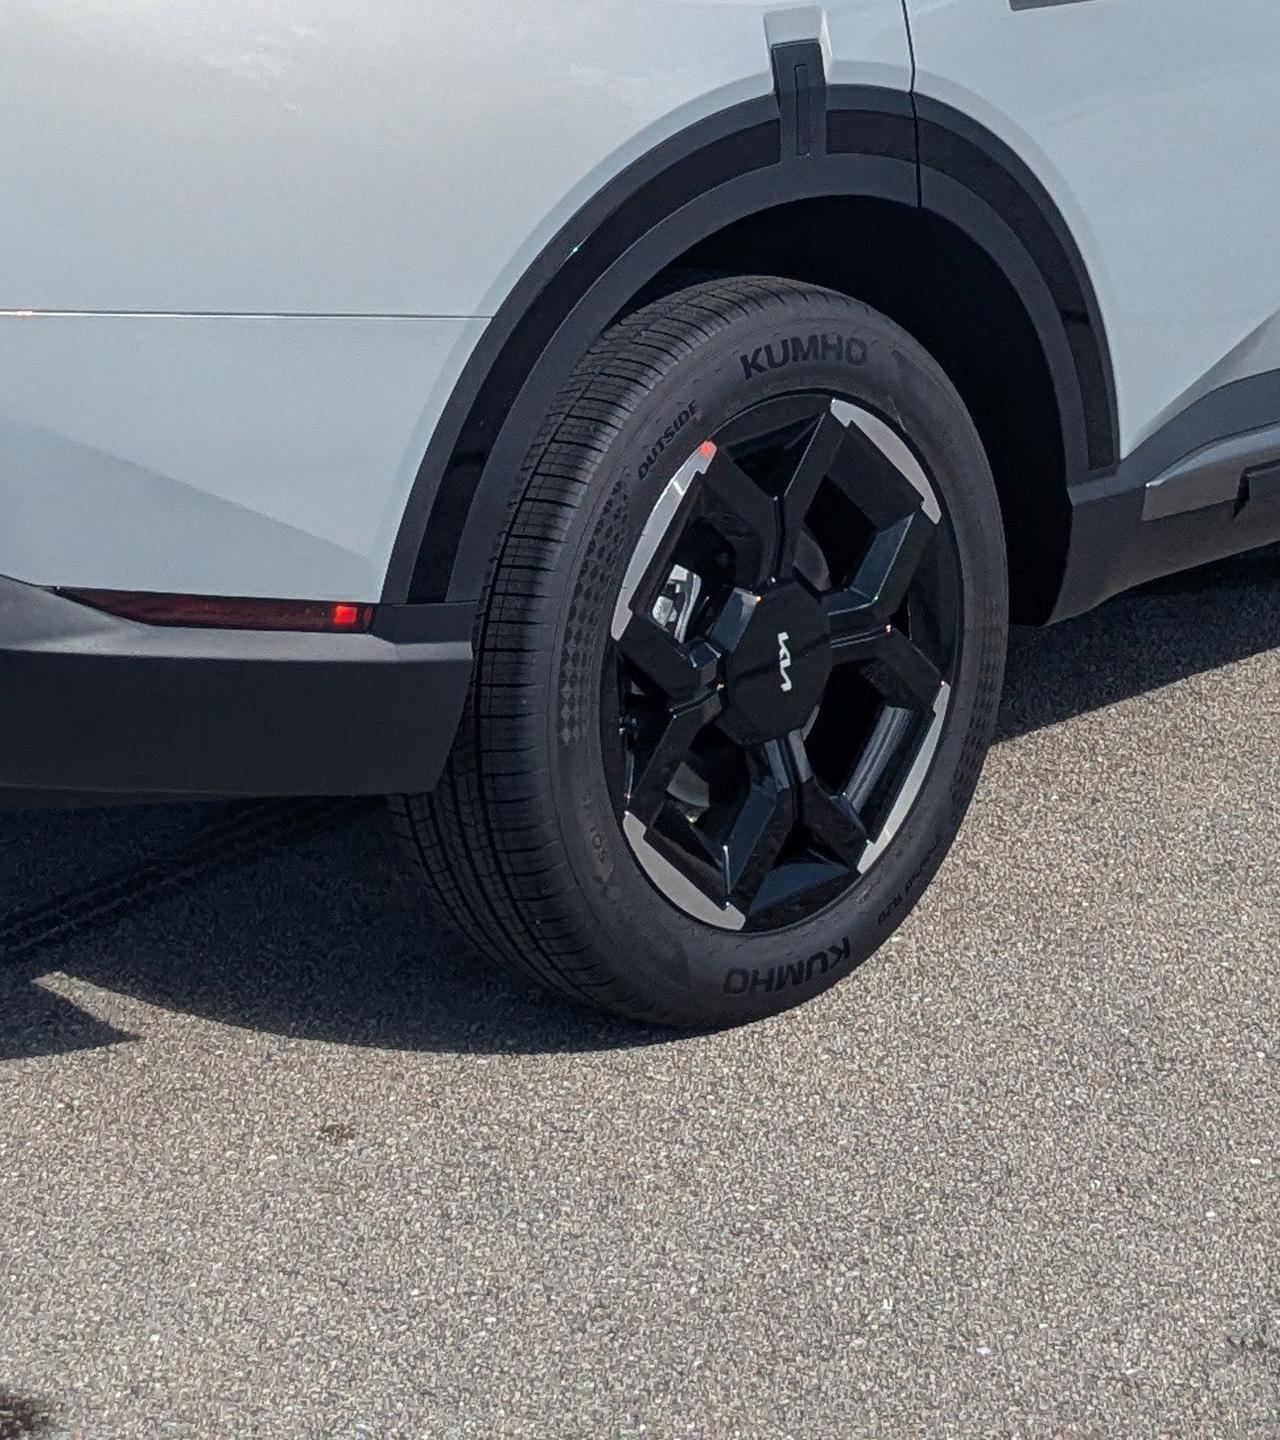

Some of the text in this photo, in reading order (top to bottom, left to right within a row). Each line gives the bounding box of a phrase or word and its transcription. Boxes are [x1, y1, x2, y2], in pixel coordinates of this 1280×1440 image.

[739, 333, 869, 381] KUMHO
[637, 399, 698, 481] OUTSIDE
[722, 936, 851, 995] KUMHO
